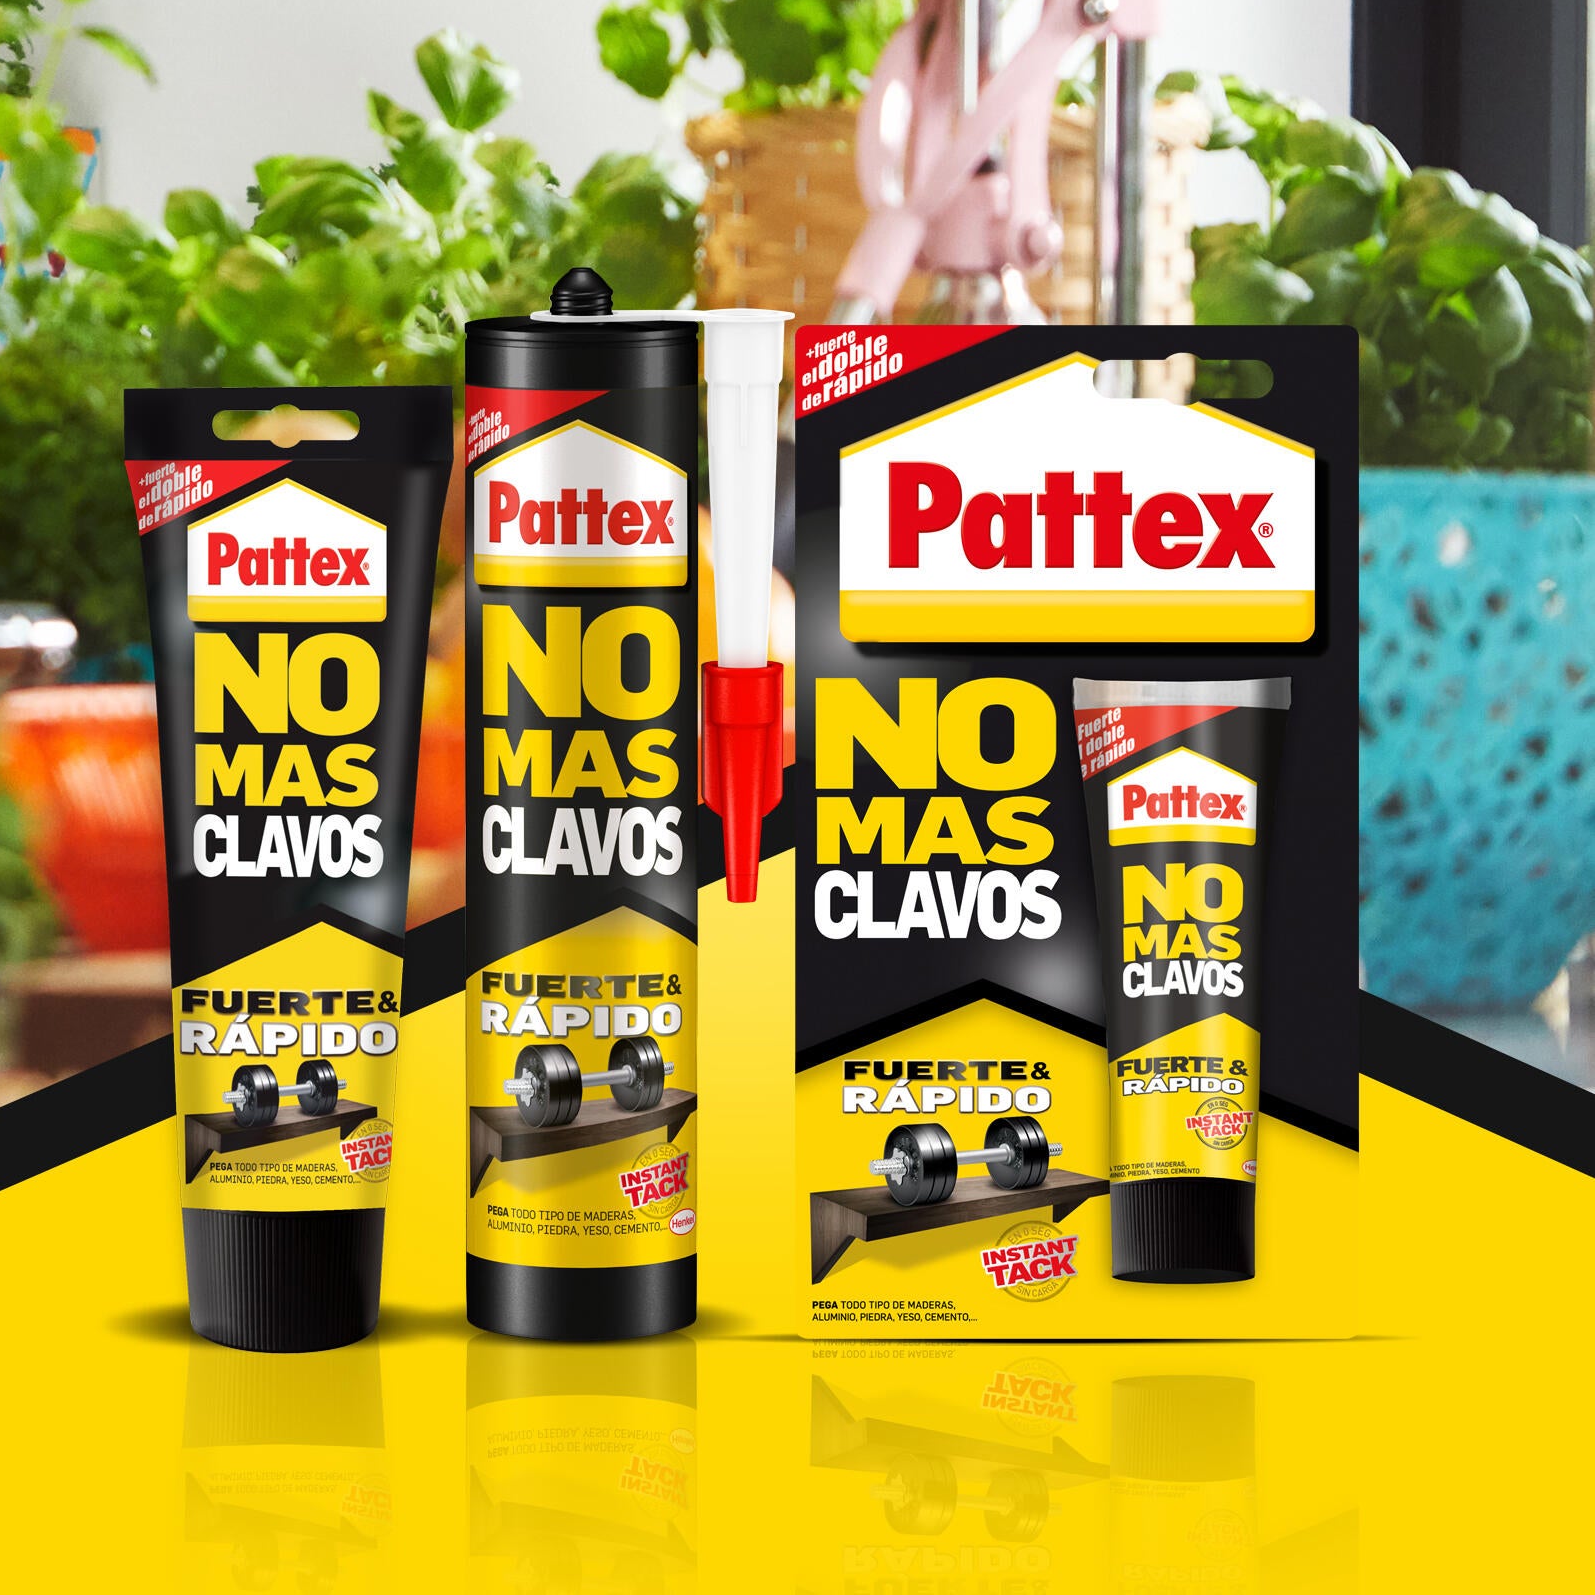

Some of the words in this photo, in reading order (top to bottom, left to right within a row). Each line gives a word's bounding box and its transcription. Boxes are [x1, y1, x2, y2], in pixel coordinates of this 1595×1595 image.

[806, 329, 856, 358] +fuerte
[482, 604, 681, 721] NO
[194, 632, 380, 736] NO
[815, 677, 1056, 791] NO
[1086, 724, 1124, 756] doble
[483, 727, 680, 799] MAS
[1091, 737, 1135, 773] rápido
[195, 743, 378, 807] MAS
[193, 813, 384, 878] CLAVOS
[482, 804, 683, 876] CLAVOS
[817, 795, 1055, 866] MAS
[814, 869, 1062, 940] CLAVOS
[1122, 862, 1244, 925] NO
[1123, 923, 1242, 963] MAS
[1122, 959, 1244, 998] CLAVOS
[179, 1012, 398, 1056] RÁPIDO
[480, 995, 683, 1038] RÁPIDO
[1117, 1056, 1224, 1077] FUERTE
[1122, 1073, 1244, 1096] RÁPIDO
[842, 1078, 1052, 1114] RÁPIDO
[1186, 1112, 1254, 1129] INSTANT
[1201, 1123, 1243, 1137] TACK
[342, 1134, 392, 1154] INSTAN
[210, 1162, 233, 1171] PEGA
[235, 1163, 256, 1172] TODO
[260, 1163, 280, 1172] TIPO
[282, 1163, 293, 1172] DE
[296, 1163, 338, 1172] MADERAS,
[210, 1175, 254, 1185] ALUMINIO,
[256, 1175, 289, 1185] PIEDRA,
[291, 1175, 313, 1185] YESO,
[620, 1152, 689, 1188] INSTANT
[624, 1170, 689, 1207] TACK
[487, 1204, 509, 1217] PEGA
[511, 1207, 535, 1219] TODO
[539, 1210, 564, 1221] TIPO
[567, 1211, 580, 1221] DE
[583, 1210, 636, 1221] MADERAS,
[487, 1219, 535, 1235] ALUMINIO,
[537, 1224, 579, 1235] PIEDRA,
[583, 1225, 611, 1236] YESO,
[671, 1214, 695, 1229] Henkel
[982, 1237, 1078, 1266] INSTANT
[987, 1253, 1076, 1286] TACK
[812, 1300, 838, 1310] PEGA
[841, 1300, 866, 1310] TODO
[869, 1300, 890, 1310] TIPO
[893, 1300, 904, 1310] DE
[908, 1300, 956, 1311] MADERAS,
[1016, 1285, 1030, 1297] SIN
[1032, 1281, 1058, 1297] CARGA
[812, 1312, 858, 1322] ALUMINIO,
[860, 1312, 895, 1322] PIEDRA,
[897, 1312, 922, 1322] YESO,
